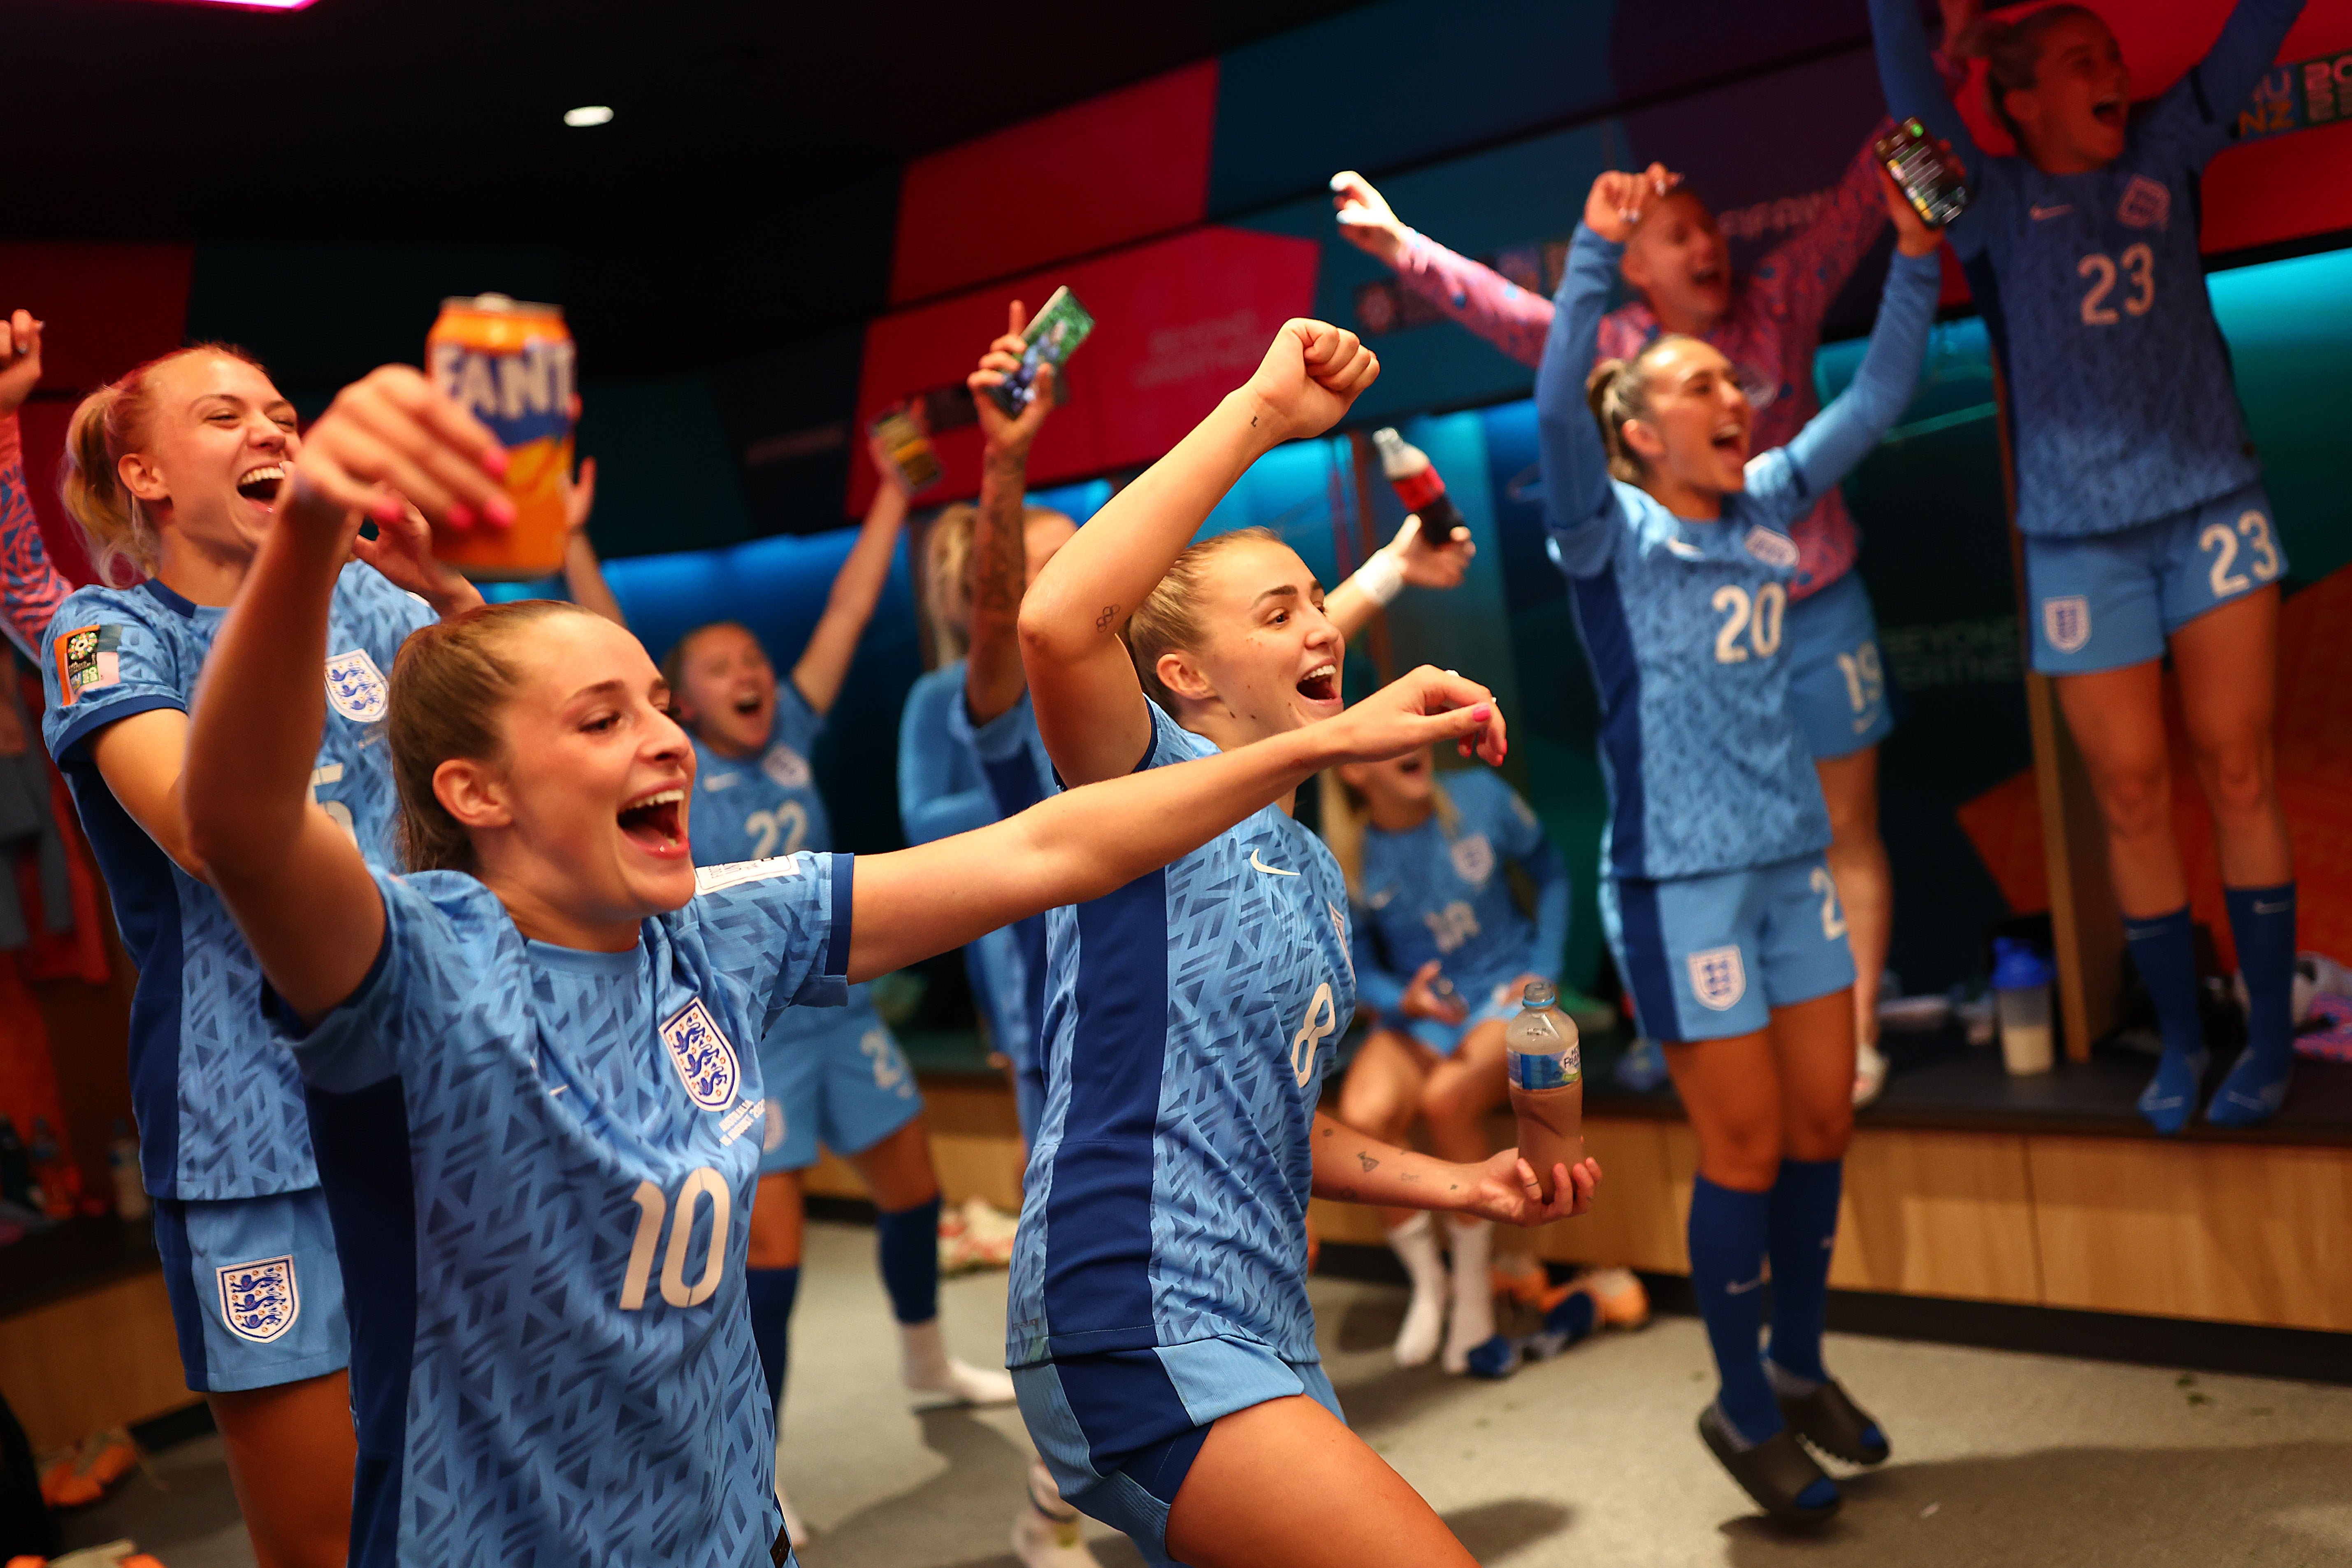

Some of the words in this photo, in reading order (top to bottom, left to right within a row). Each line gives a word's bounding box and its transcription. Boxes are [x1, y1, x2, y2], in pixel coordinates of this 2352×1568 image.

[2078, 242, 2155, 326] 23
[432, 337, 577, 420] FANT
[2199, 508, 2280, 598] 23
[1711, 581, 1788, 664] 20
[1836, 640, 1885, 713] 19
[744, 799, 809, 860] 22
[1291, 983, 1336, 1089] 8
[619, 1166, 731, 1310] 10
